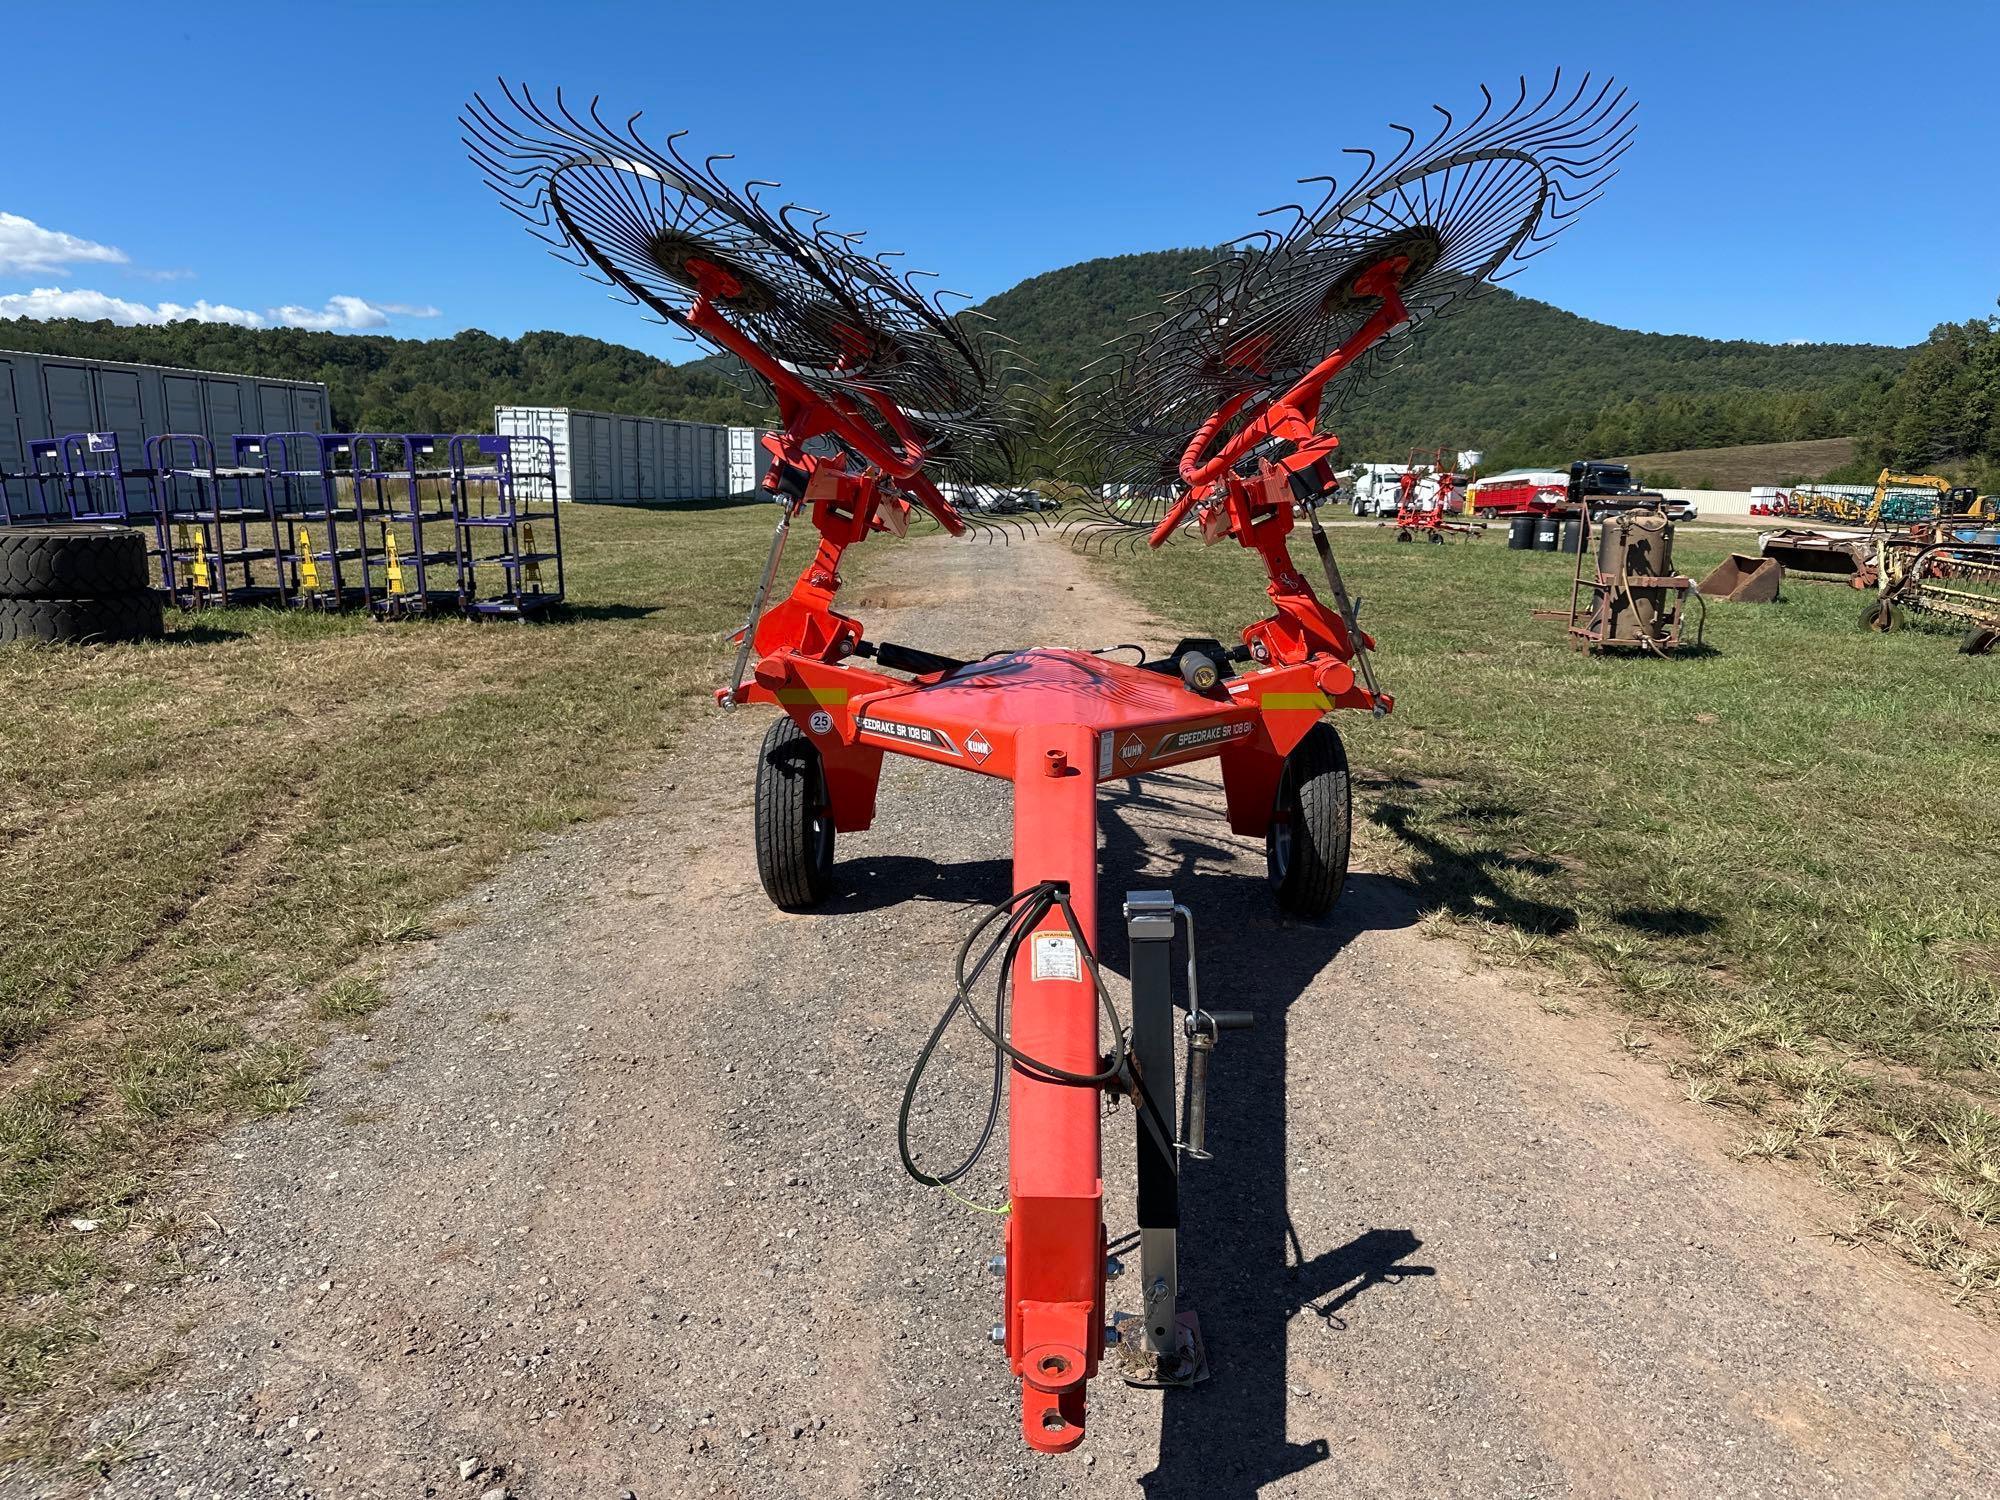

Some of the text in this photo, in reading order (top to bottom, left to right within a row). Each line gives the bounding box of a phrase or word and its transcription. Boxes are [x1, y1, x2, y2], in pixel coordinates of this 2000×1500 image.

[813, 715, 828, 726] 25
[856, 716, 895, 735] SPEEDRAKE
[897, 725, 907, 737] SR
[908, 726, 921, 740] 108
[1178, 727, 1221, 746] SPEEDRAKE
[1222, 725, 1232, 737] SR
[1232, 723, 1243, 735] 108
[967, 740, 989, 755] KUHN
[1122, 743, 1142, 759] KUHN
